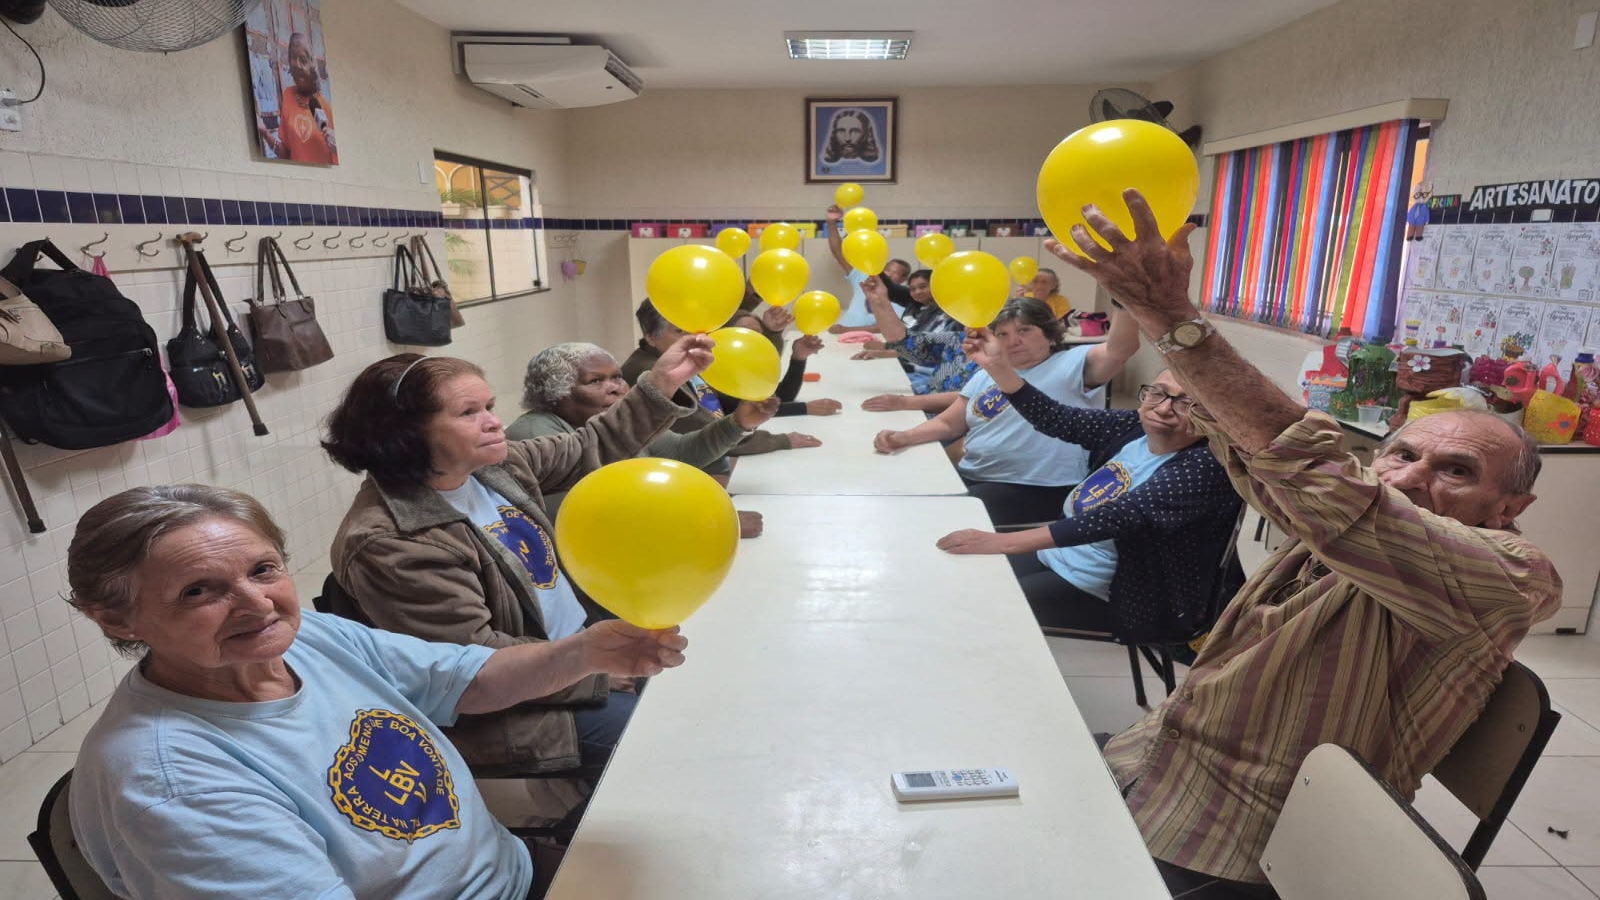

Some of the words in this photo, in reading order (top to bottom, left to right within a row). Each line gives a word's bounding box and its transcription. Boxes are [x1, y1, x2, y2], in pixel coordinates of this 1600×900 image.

[1469, 179, 1600, 211] ARTESANATO
[389, 720, 418, 742] BOA
[343, 757, 359, 781] AOS
[418, 740, 445, 796] VONTADE
[347, 785, 389, 824] TERRA
